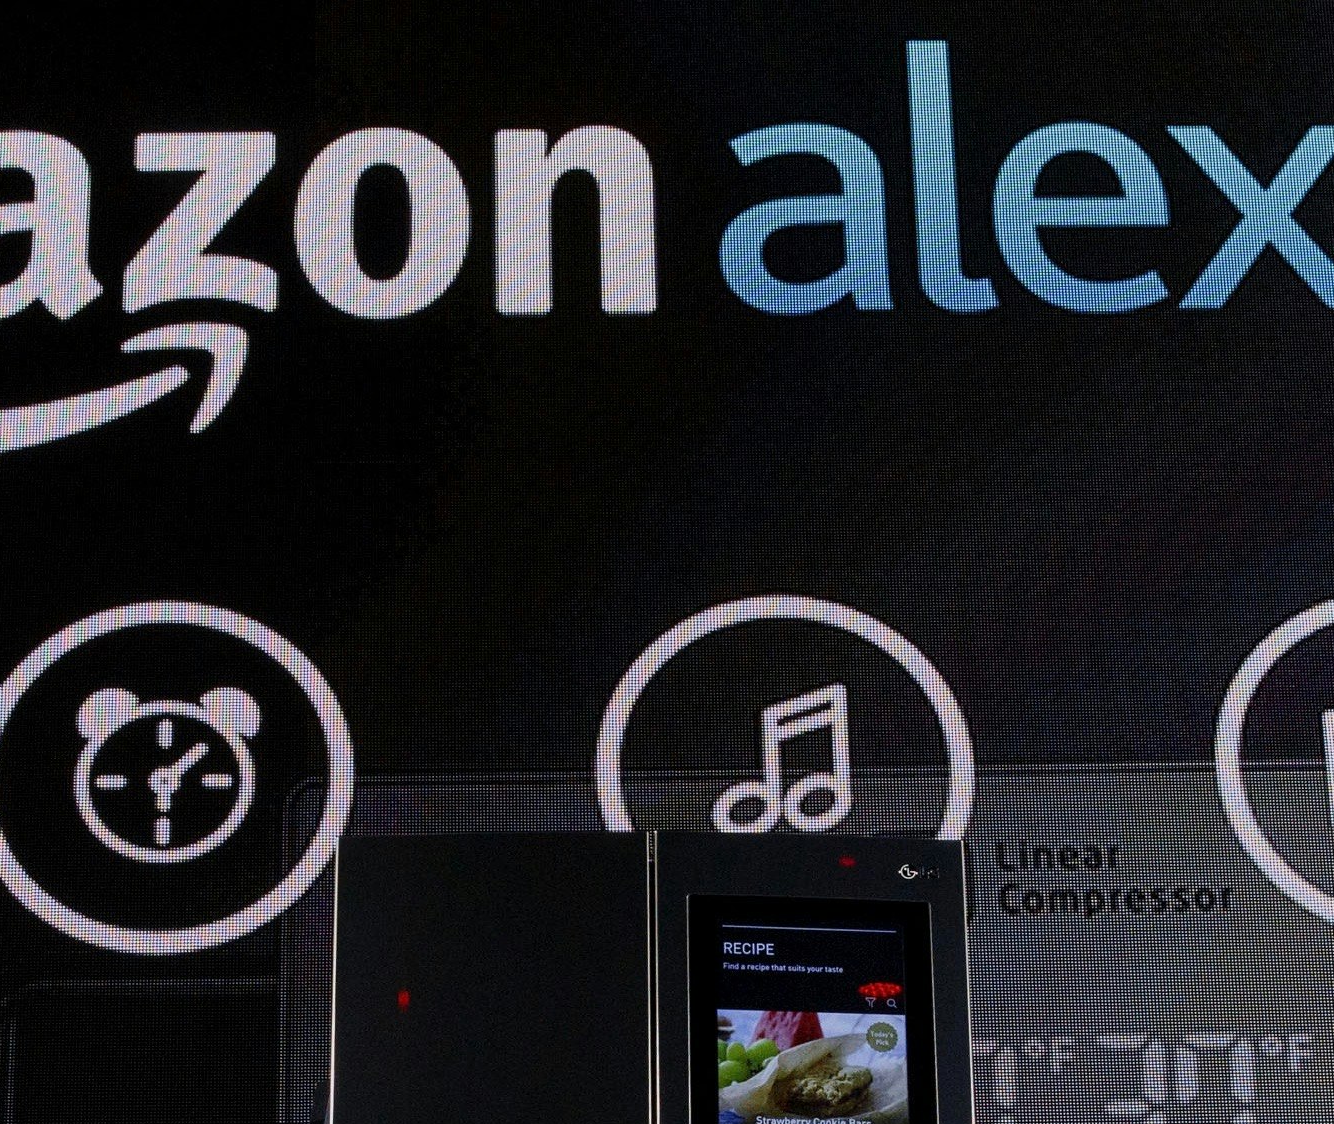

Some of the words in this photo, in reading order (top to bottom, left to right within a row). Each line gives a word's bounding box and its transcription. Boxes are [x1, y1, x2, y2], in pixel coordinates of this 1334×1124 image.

[996, 841, 1117, 871] Linear
[1000, 883, 1232, 917] Compressor
[723, 942, 775, 956] RECIPE
[723, 962, 739, 970] Find
[747, 963, 770, 972] recipe
[788, 964, 805, 972] suits
